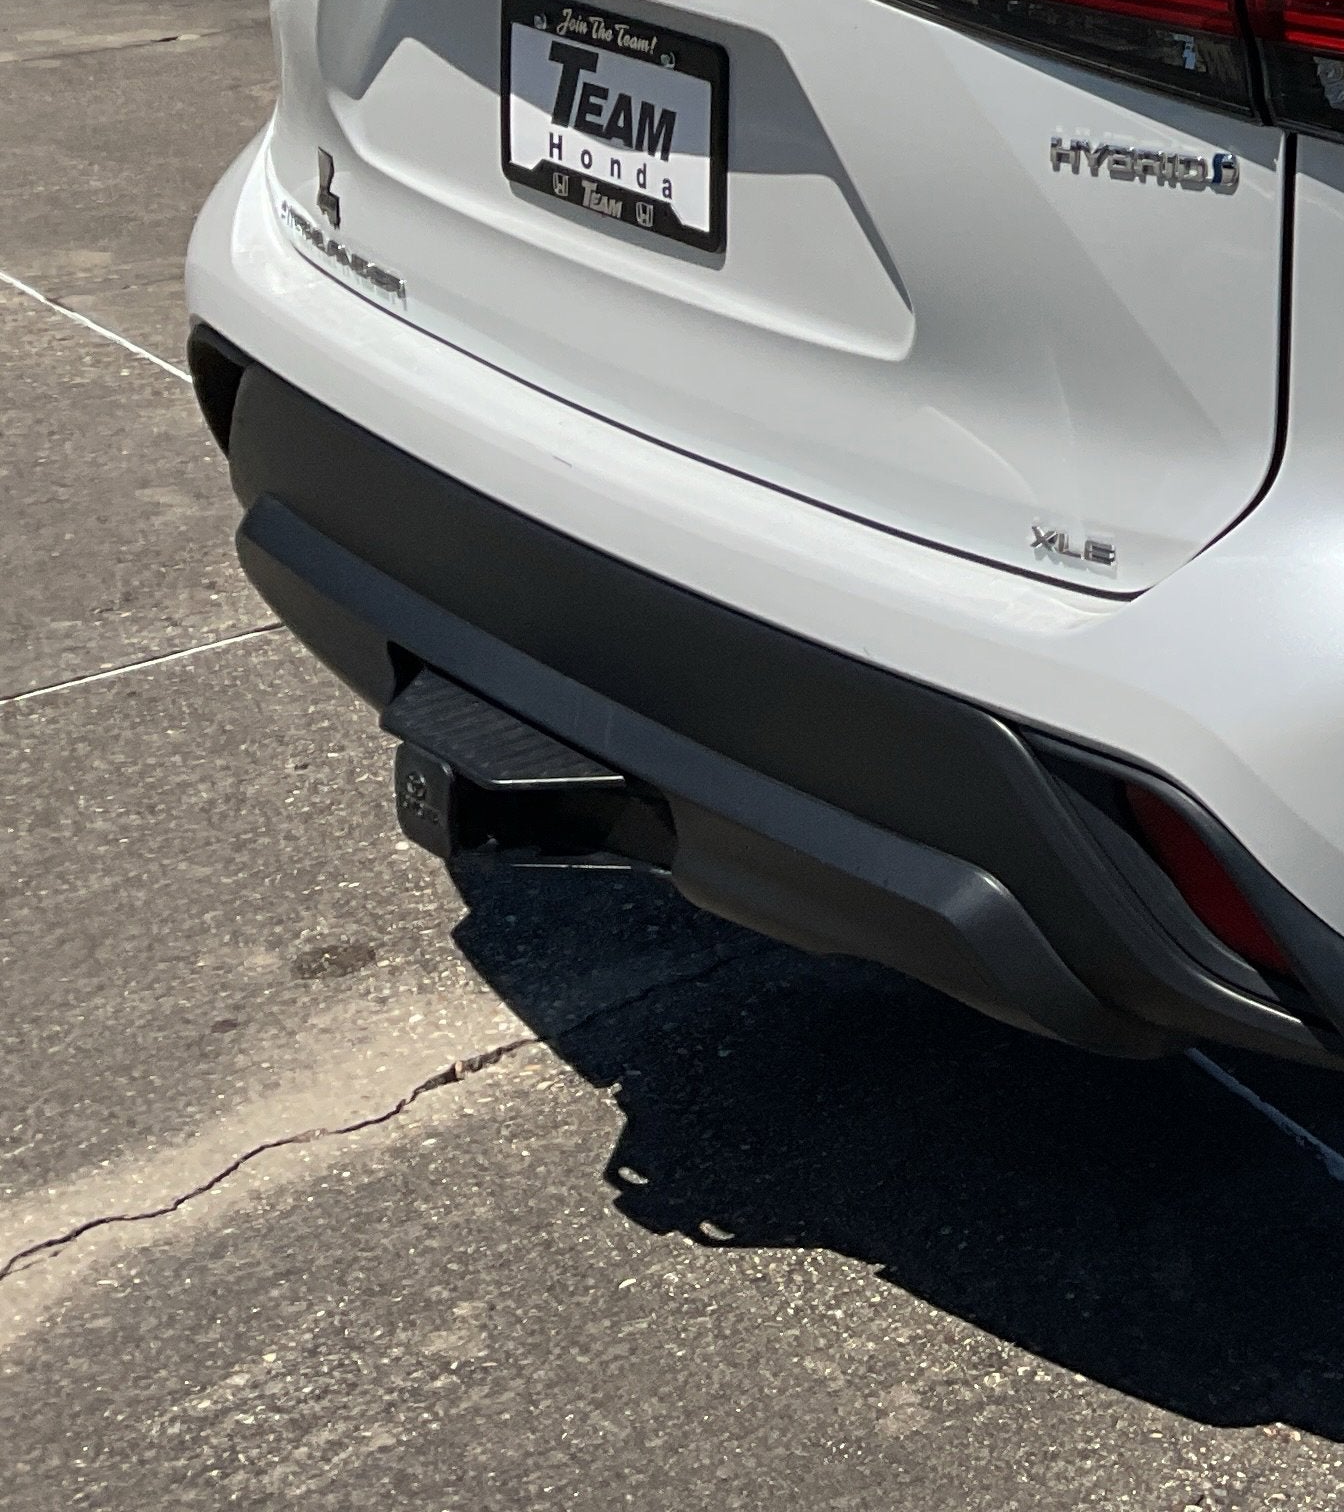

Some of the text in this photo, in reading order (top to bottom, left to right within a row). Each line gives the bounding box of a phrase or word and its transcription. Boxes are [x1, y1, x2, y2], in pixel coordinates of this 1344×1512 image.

[556, 8, 658, 55] Join The Team!
[549, 132, 673, 199] Honda
[1050, 136, 1209, 187] HYBRID
[1030, 525, 1115, 567] XLE
